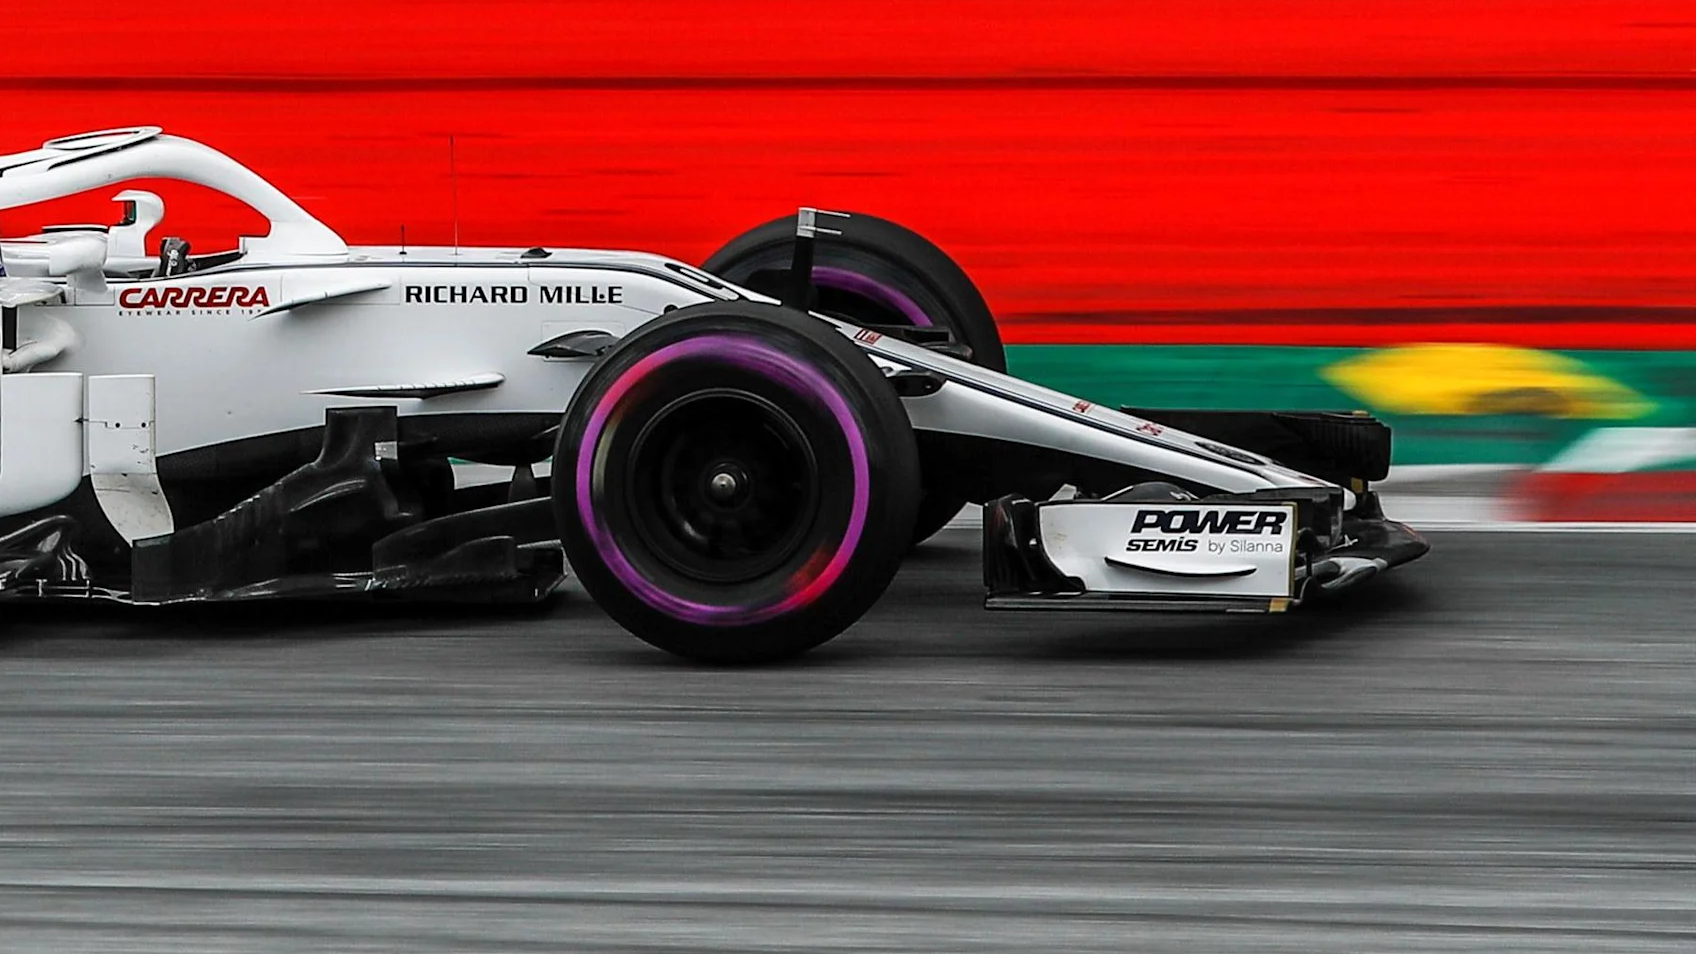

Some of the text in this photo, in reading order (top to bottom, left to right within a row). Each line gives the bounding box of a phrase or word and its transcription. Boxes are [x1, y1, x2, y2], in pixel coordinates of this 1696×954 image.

[119, 286, 270, 309] CARRERA
[405, 285, 623, 304] RICHARD MILLE
[118, 309, 181, 317] EYEWEAR
[191, 308, 231, 316] SINCE
[1130, 510, 1288, 535] POWER
[1208, 540, 1226, 555] by
[1230, 539, 1283, 553] Silanna
